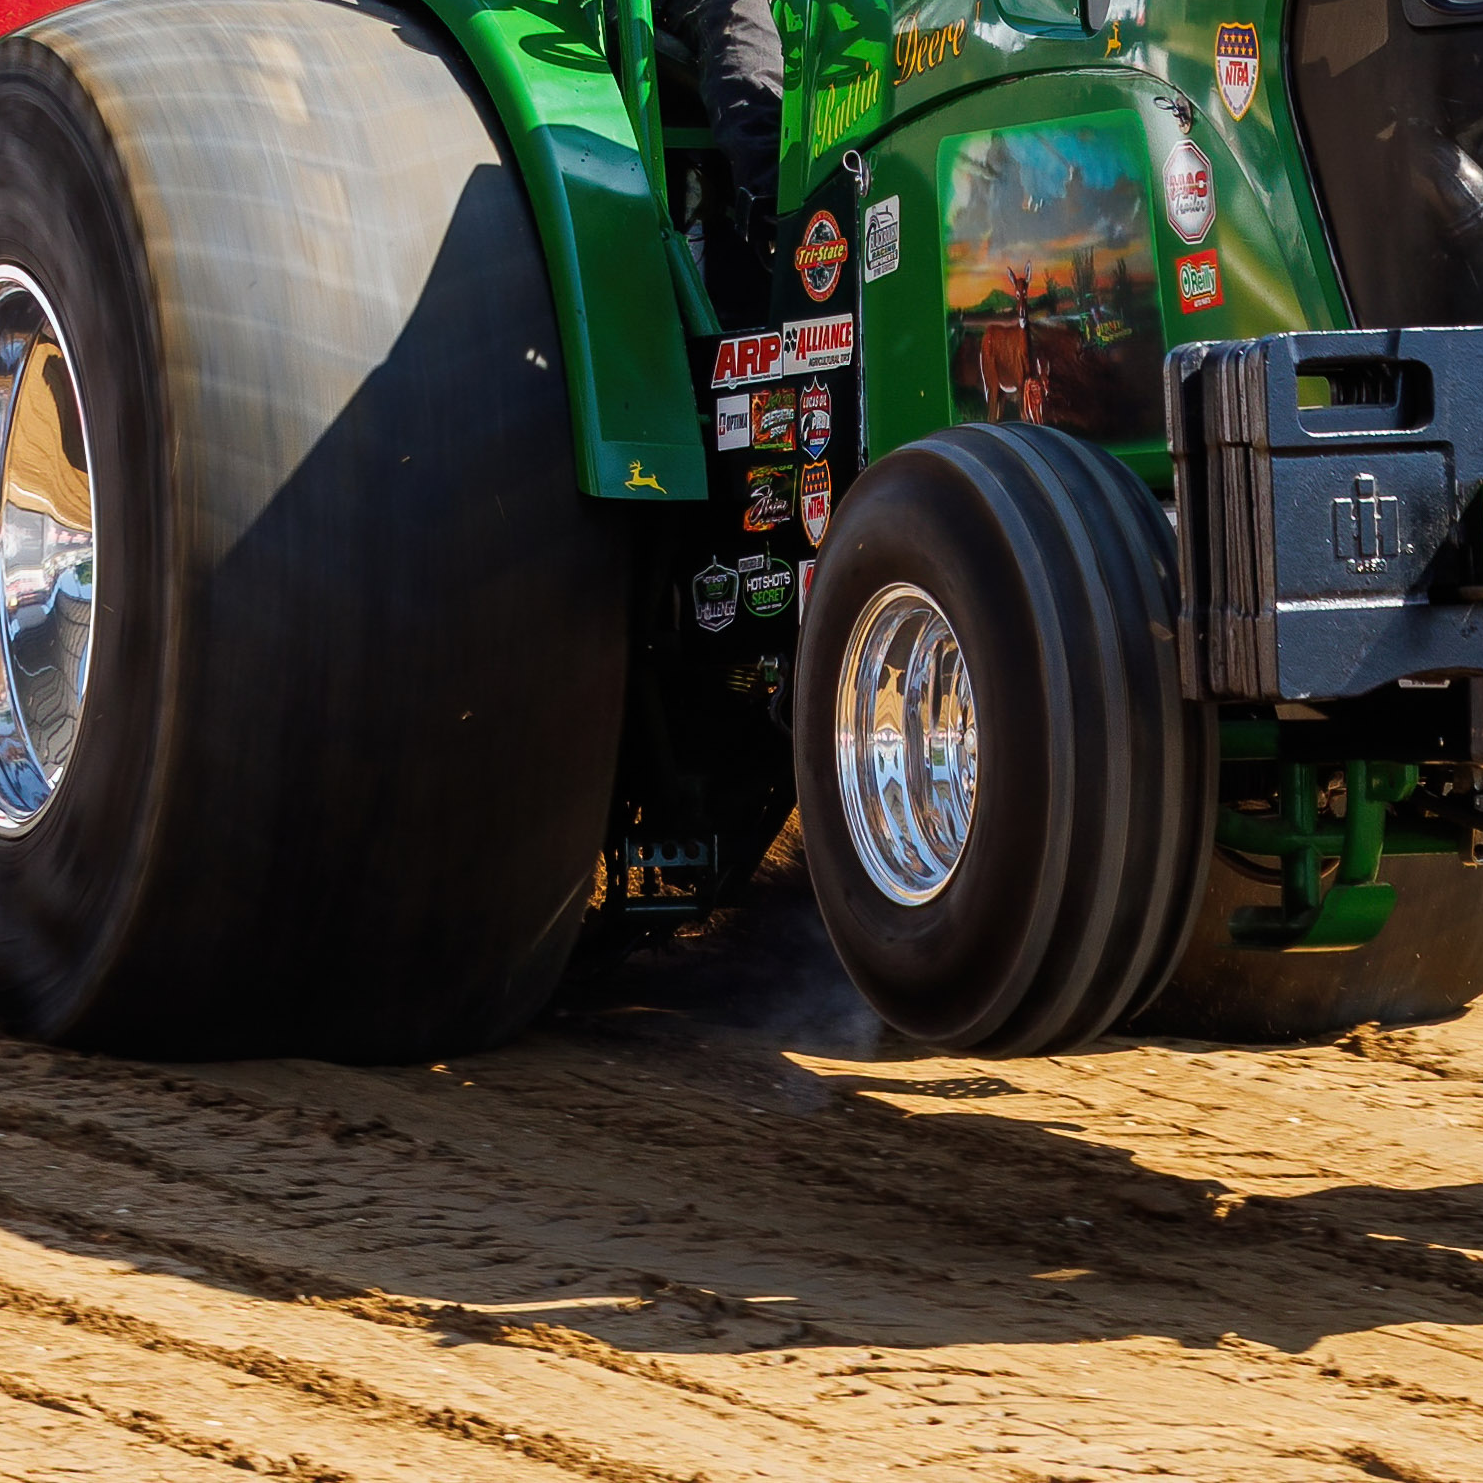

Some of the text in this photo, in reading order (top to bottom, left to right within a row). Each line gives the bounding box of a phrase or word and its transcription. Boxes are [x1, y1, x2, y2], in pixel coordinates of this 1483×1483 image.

[893, 10, 968, 87] Deere
[1225, 61, 1249, 86] NTPA
[799, 244, 844, 266] Tri-State
[1180, 265, 1216, 299] O'Reilly
[796, 321, 852, 361] ALLIANCE
[714, 335, 781, 382] ARP
[752, 587, 786, 606] SECRET
